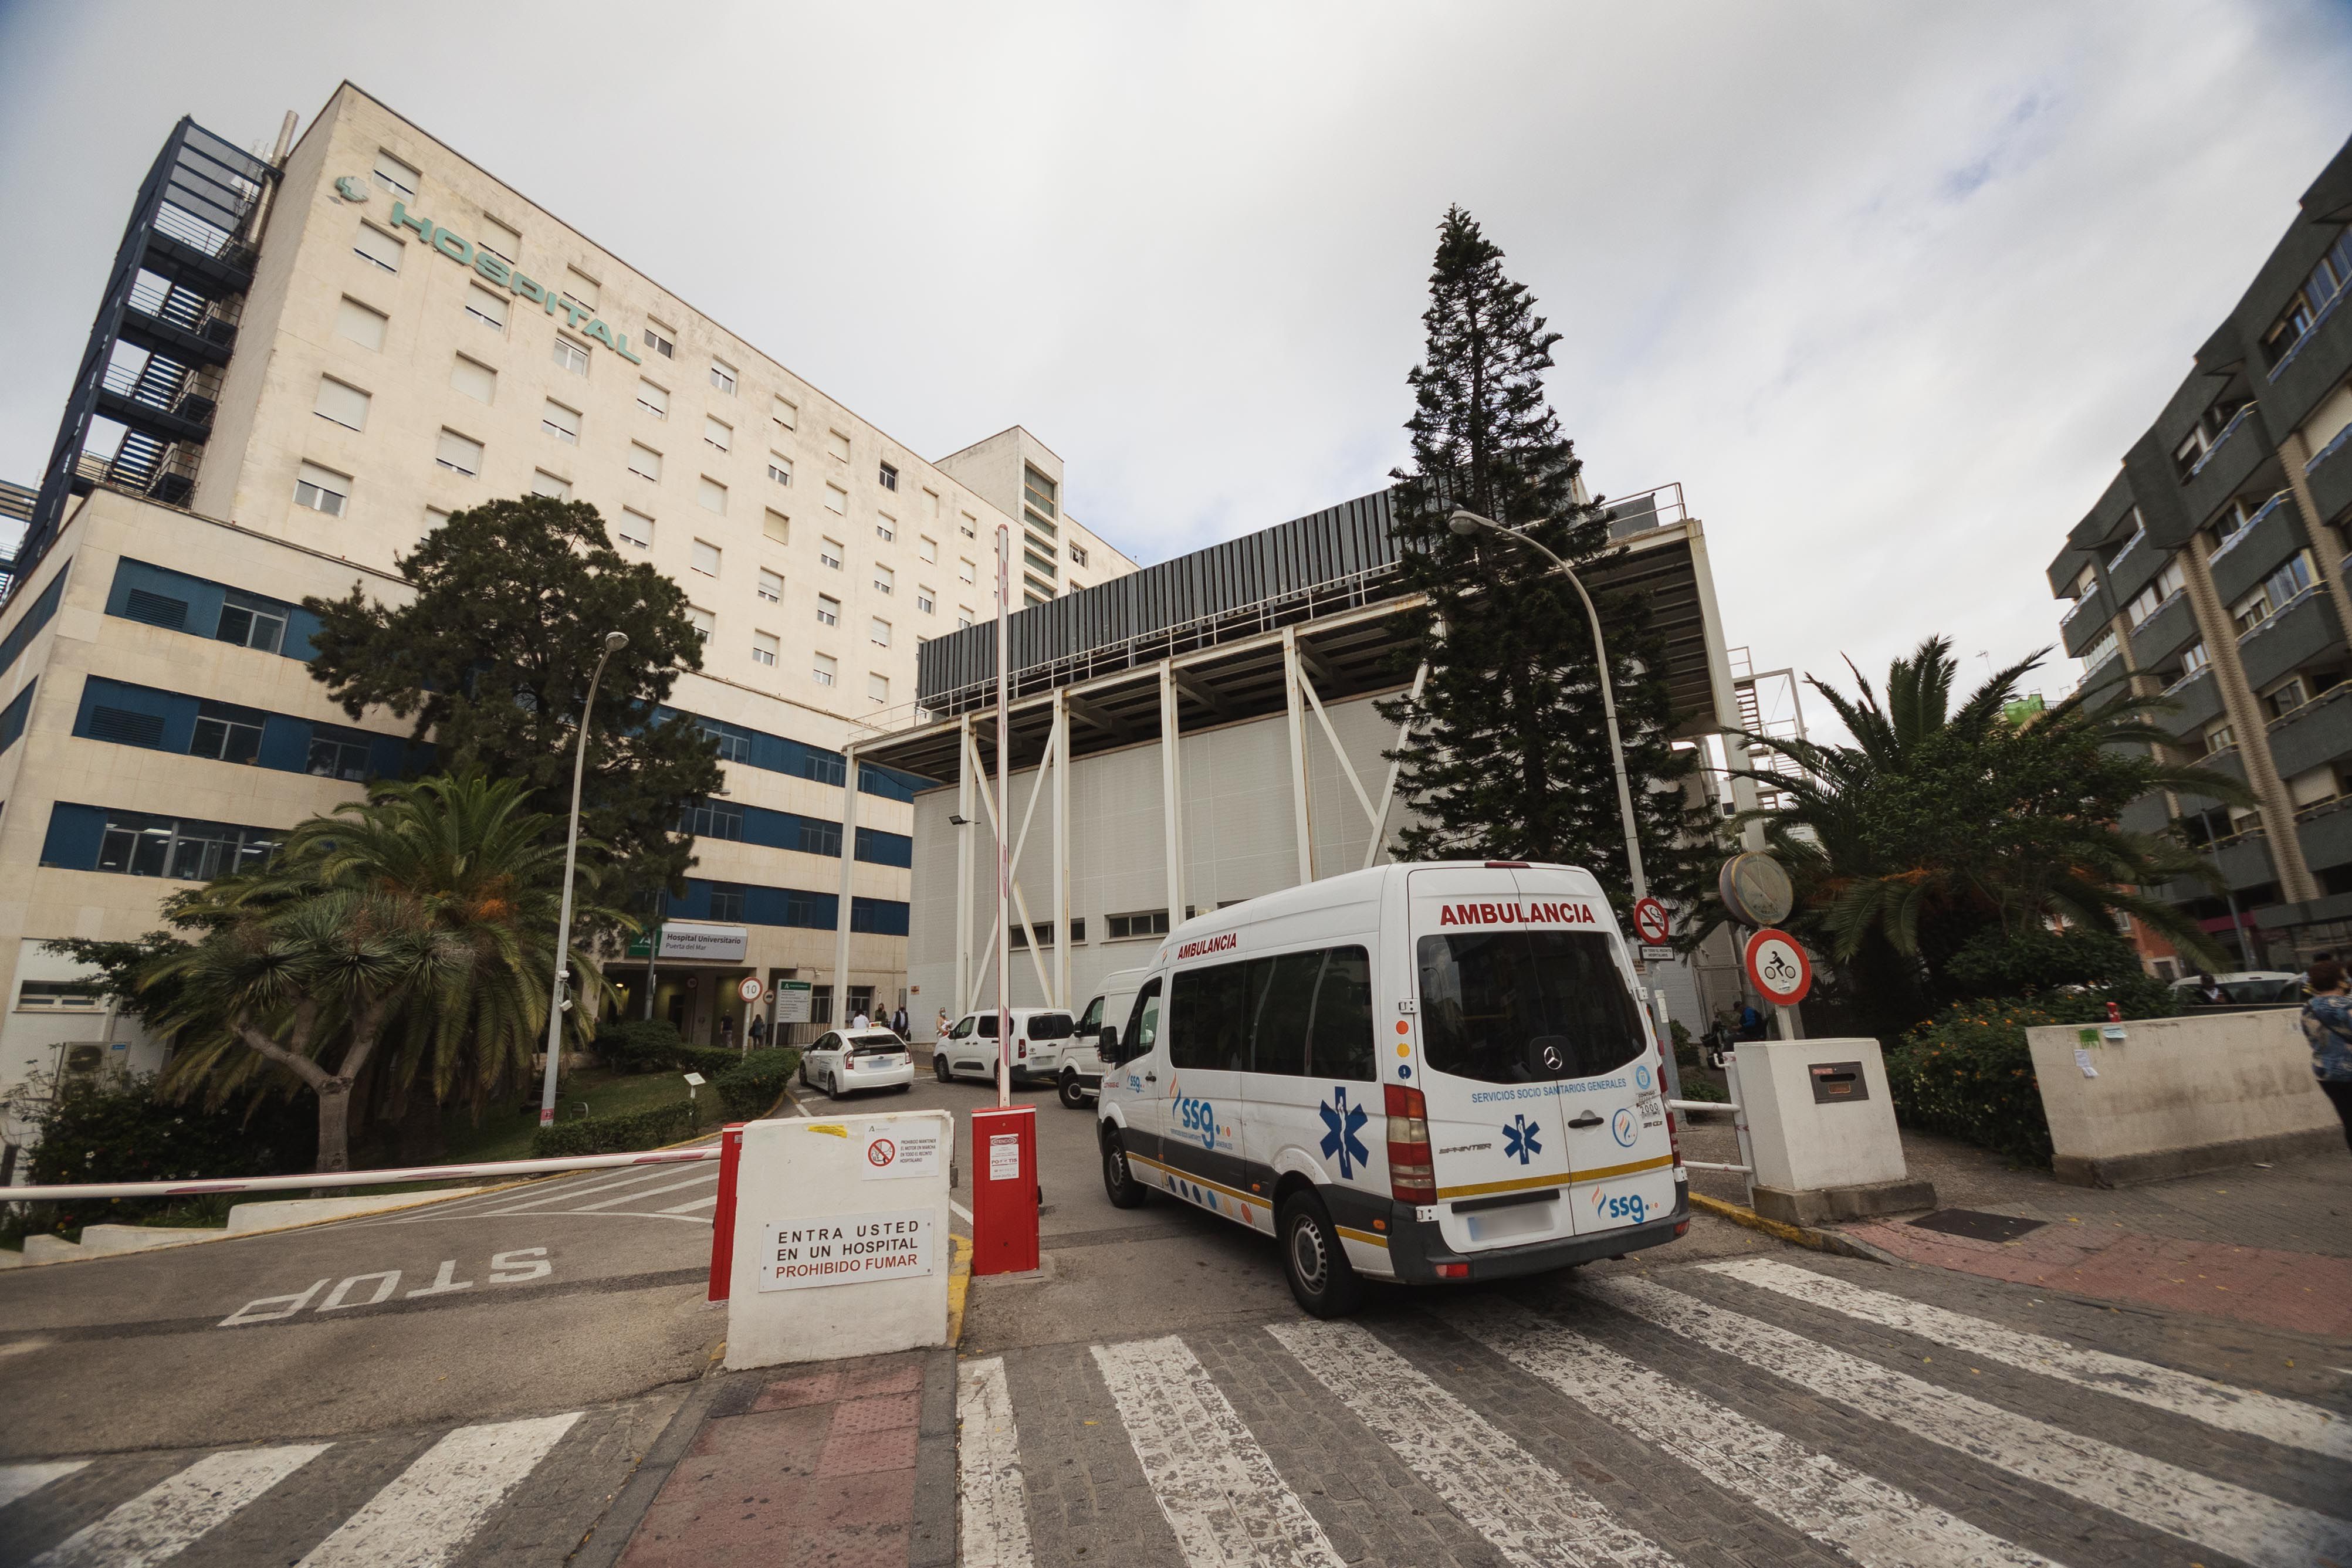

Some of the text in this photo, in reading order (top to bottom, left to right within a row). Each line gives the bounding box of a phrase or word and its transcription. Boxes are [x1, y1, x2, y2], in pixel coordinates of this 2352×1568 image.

[390, 201, 642, 365] HOSPITAL
[1440, 903, 1596, 926] AMBULANCIA
[667, 933, 742, 944] Hospital Universitario
[1177, 932, 1237, 960] AMBULANCIA
[746, 985, 757, 994] 10
[1471, 1078, 1627, 1103] SERVICIOS SOCIO SANITARIOS GENERALES
[1640, 1103, 1659, 1114] 2000
[1182, 1098, 1215, 1150] ssg
[1609, 1194, 1644, 1223] ssg
[779, 1221, 919, 1244] ENTRA USTED
[777, 1237, 918, 1261] EN UN HOSPITAL
[776, 1254, 918, 1278] PROHIBIDO FUMAR
[217, 1247, 553, 1327] STOP
